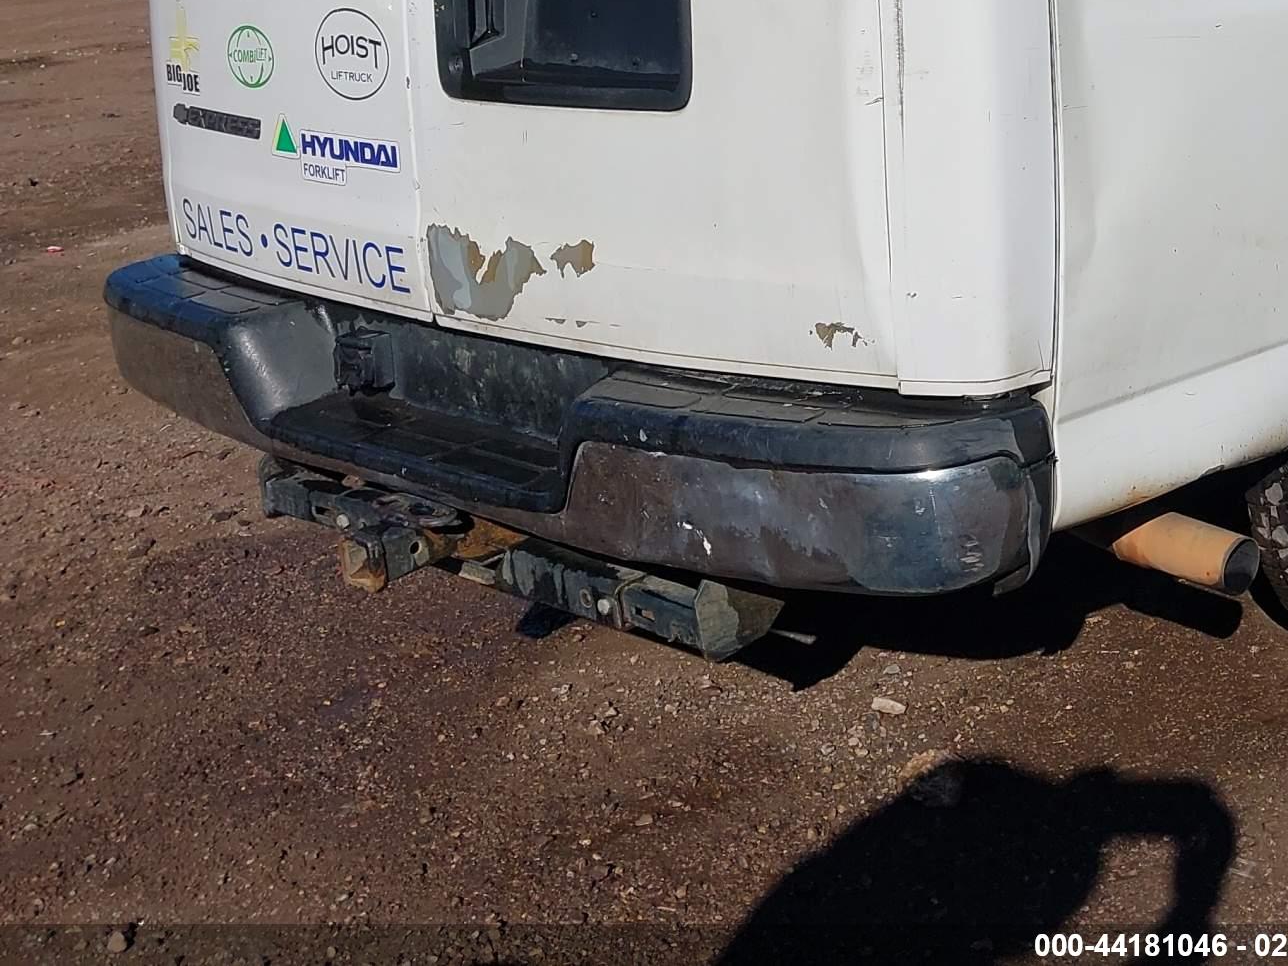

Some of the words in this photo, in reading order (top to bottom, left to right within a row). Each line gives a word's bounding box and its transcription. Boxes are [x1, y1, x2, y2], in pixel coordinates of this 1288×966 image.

[321, 34, 382, 69] HOIST
[166, 63, 183, 84] BIG
[182, 72, 200, 93] JOE
[330, 70, 373, 83] LIFTRUCK
[301, 133, 398, 168] HYUNDAI
[303, 163, 346, 182] FORKLIFT
[183, 198, 253, 256] SALES
[273, 223, 411, 294] SERVICE
